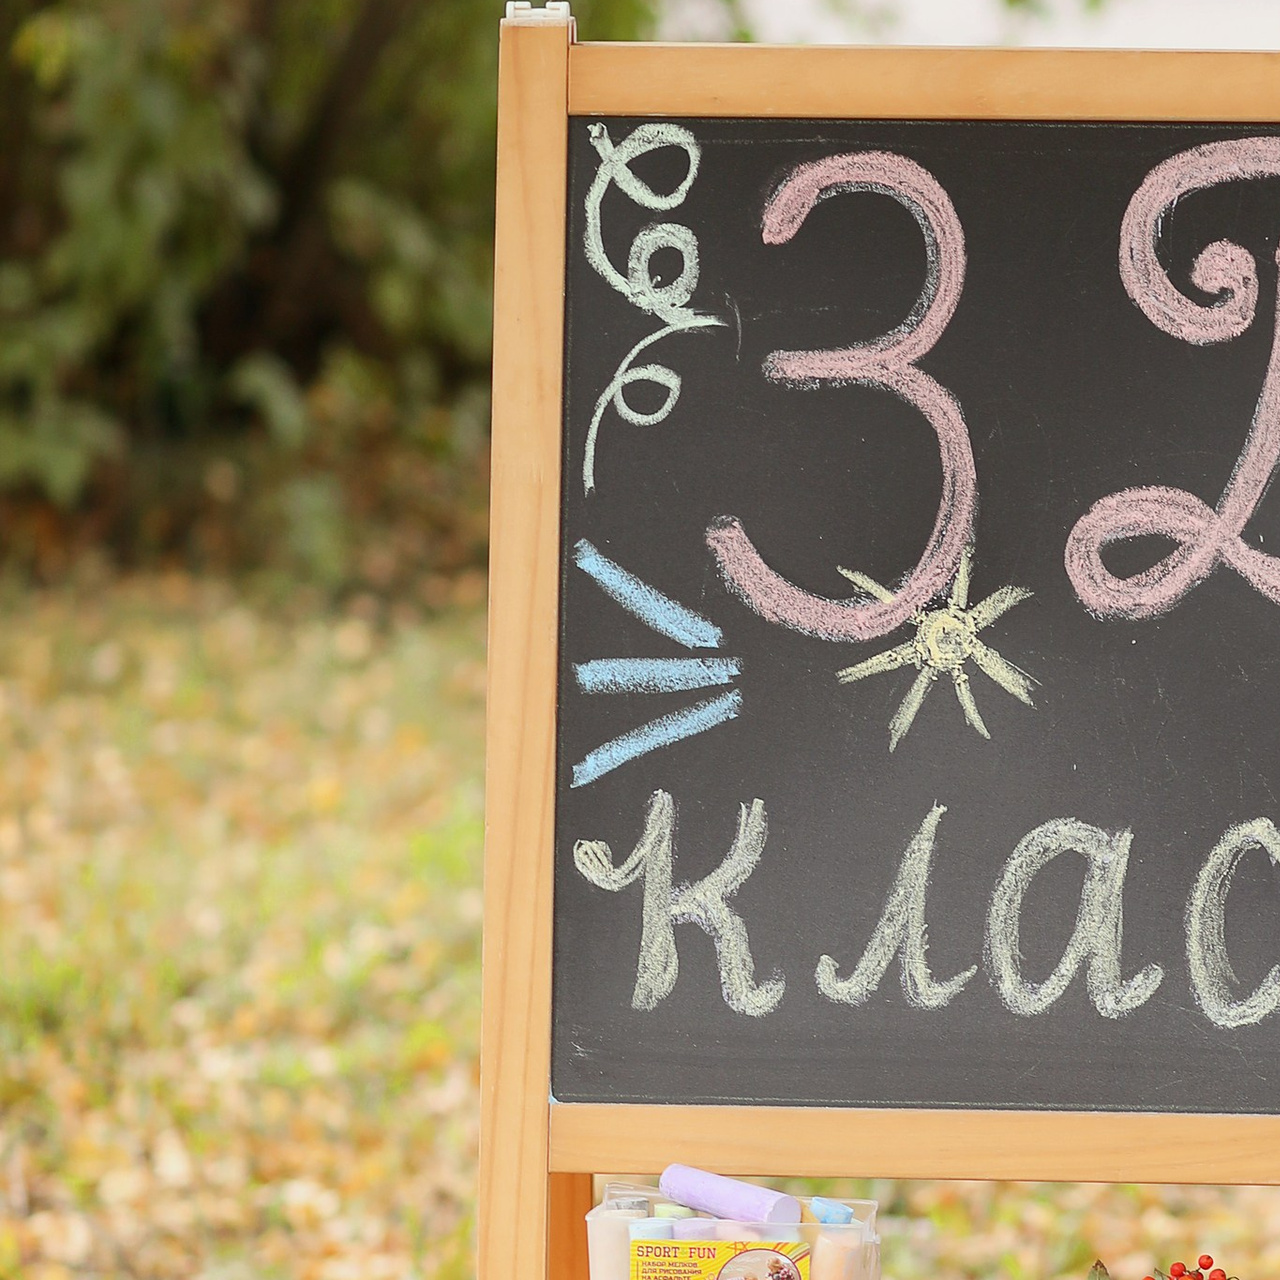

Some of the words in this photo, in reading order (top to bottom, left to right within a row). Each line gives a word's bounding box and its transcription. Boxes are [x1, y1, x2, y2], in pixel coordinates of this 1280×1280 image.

[704, 149, 979, 644] 3
[637, 1246, 680, 1258] SPORT
[688, 1247, 716, 1258] FUN
